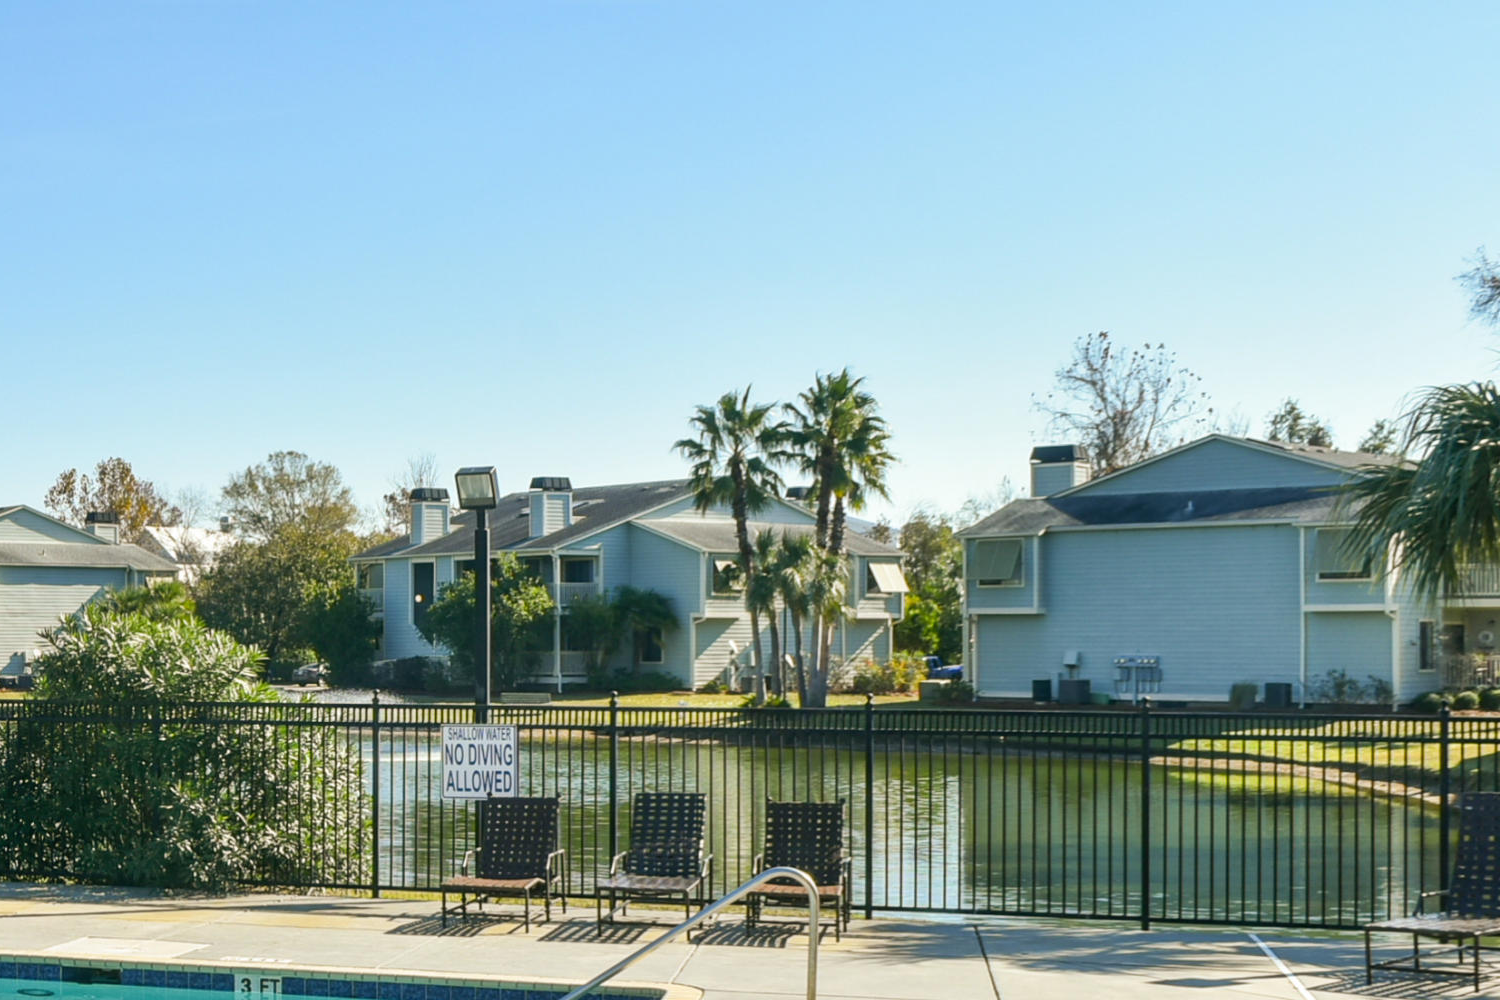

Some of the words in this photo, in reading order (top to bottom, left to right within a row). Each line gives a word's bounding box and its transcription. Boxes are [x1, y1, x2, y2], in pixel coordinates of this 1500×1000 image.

[448, 727, 483, 740] SHALLOW
[486, 727, 511, 740] WATER
[445, 743, 464, 766] NO
[468, 743, 513, 766] DIVING
[446, 770, 512, 792] ALLOWED
[240, 977, 252, 992] 3
[259, 978, 280, 994] FT
